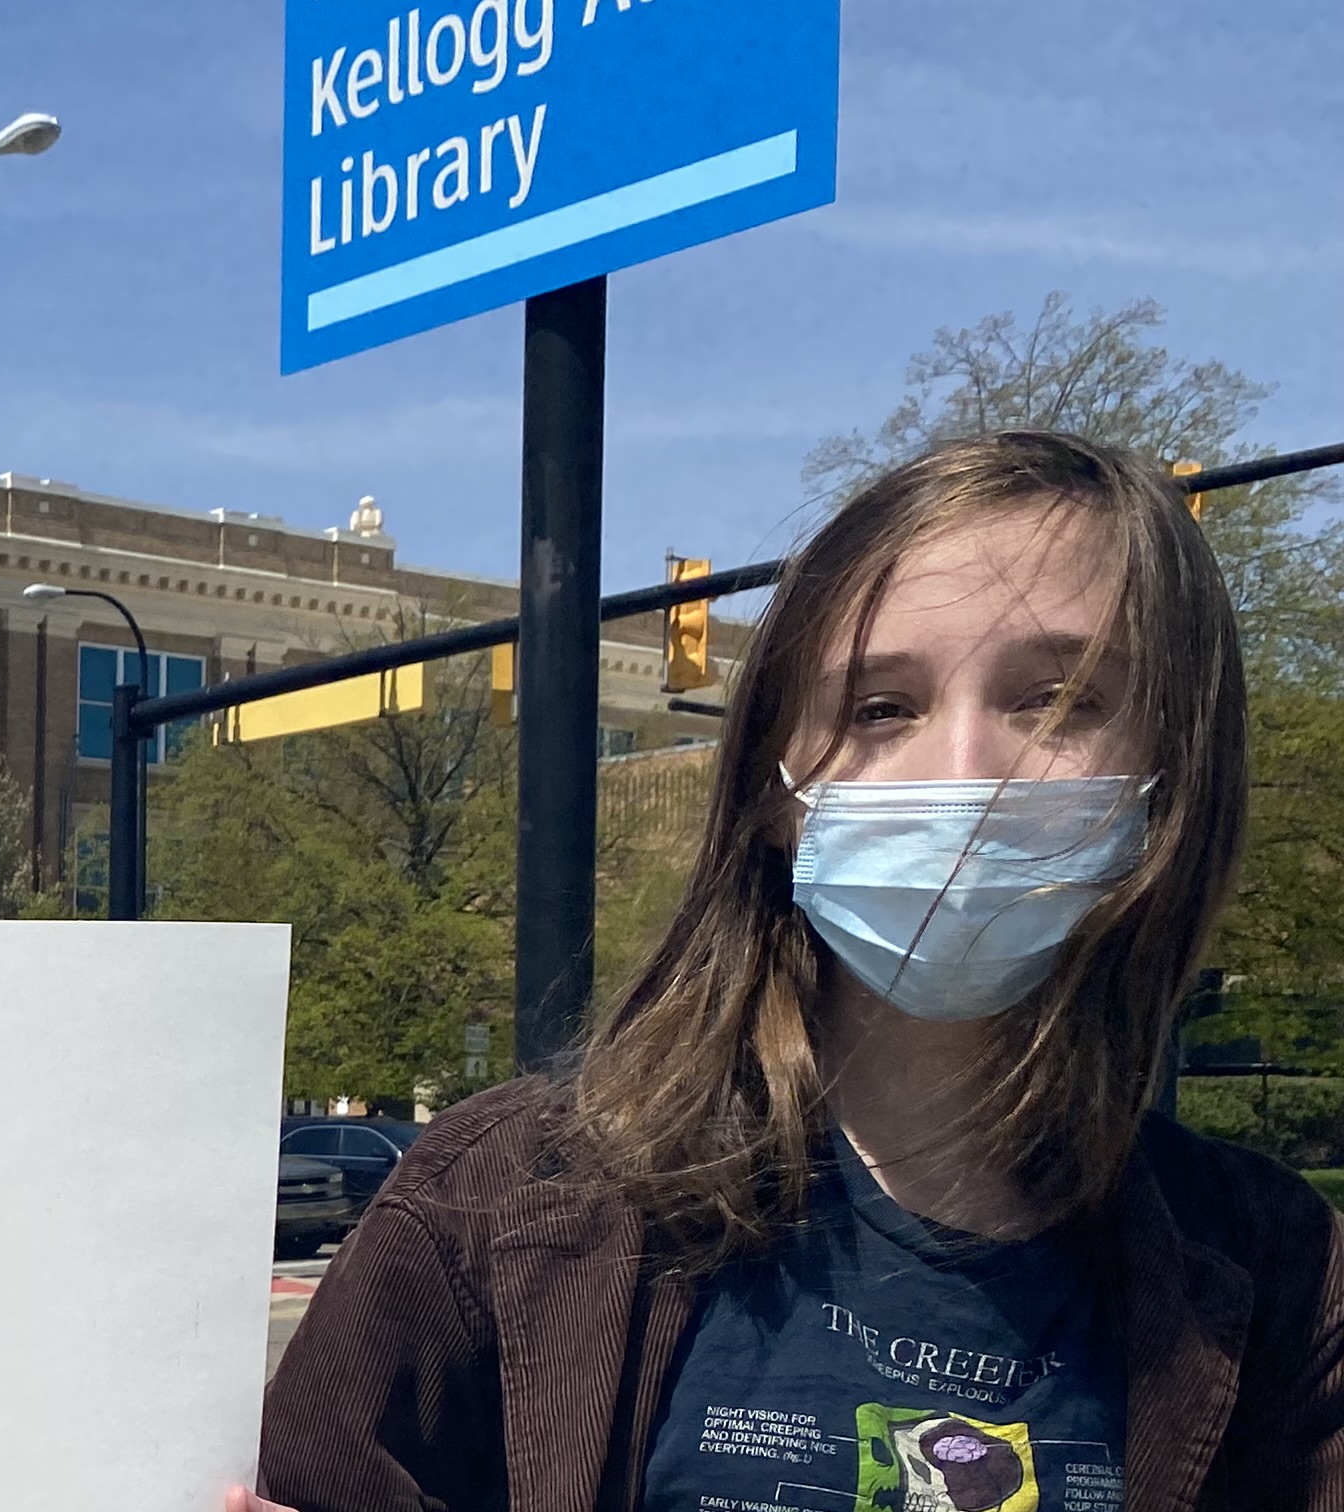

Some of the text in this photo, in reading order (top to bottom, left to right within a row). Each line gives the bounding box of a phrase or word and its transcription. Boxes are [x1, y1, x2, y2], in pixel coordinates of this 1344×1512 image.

[311, 0, 554, 136] Kellogg
[311, 103, 547, 256] Library
[821, 1302, 879, 1356] THE
[704, 1417, 822, 1439] OPTIMAL CREEPING
[706, 1406, 816, 1426] NIGHT VISION FOR
[699, 1442, 780, 1459] EVERYTHING.
[701, 1429, 837, 1455] AND IDENTIFYING NICE
[700, 1495, 738, 1510] EARLY
